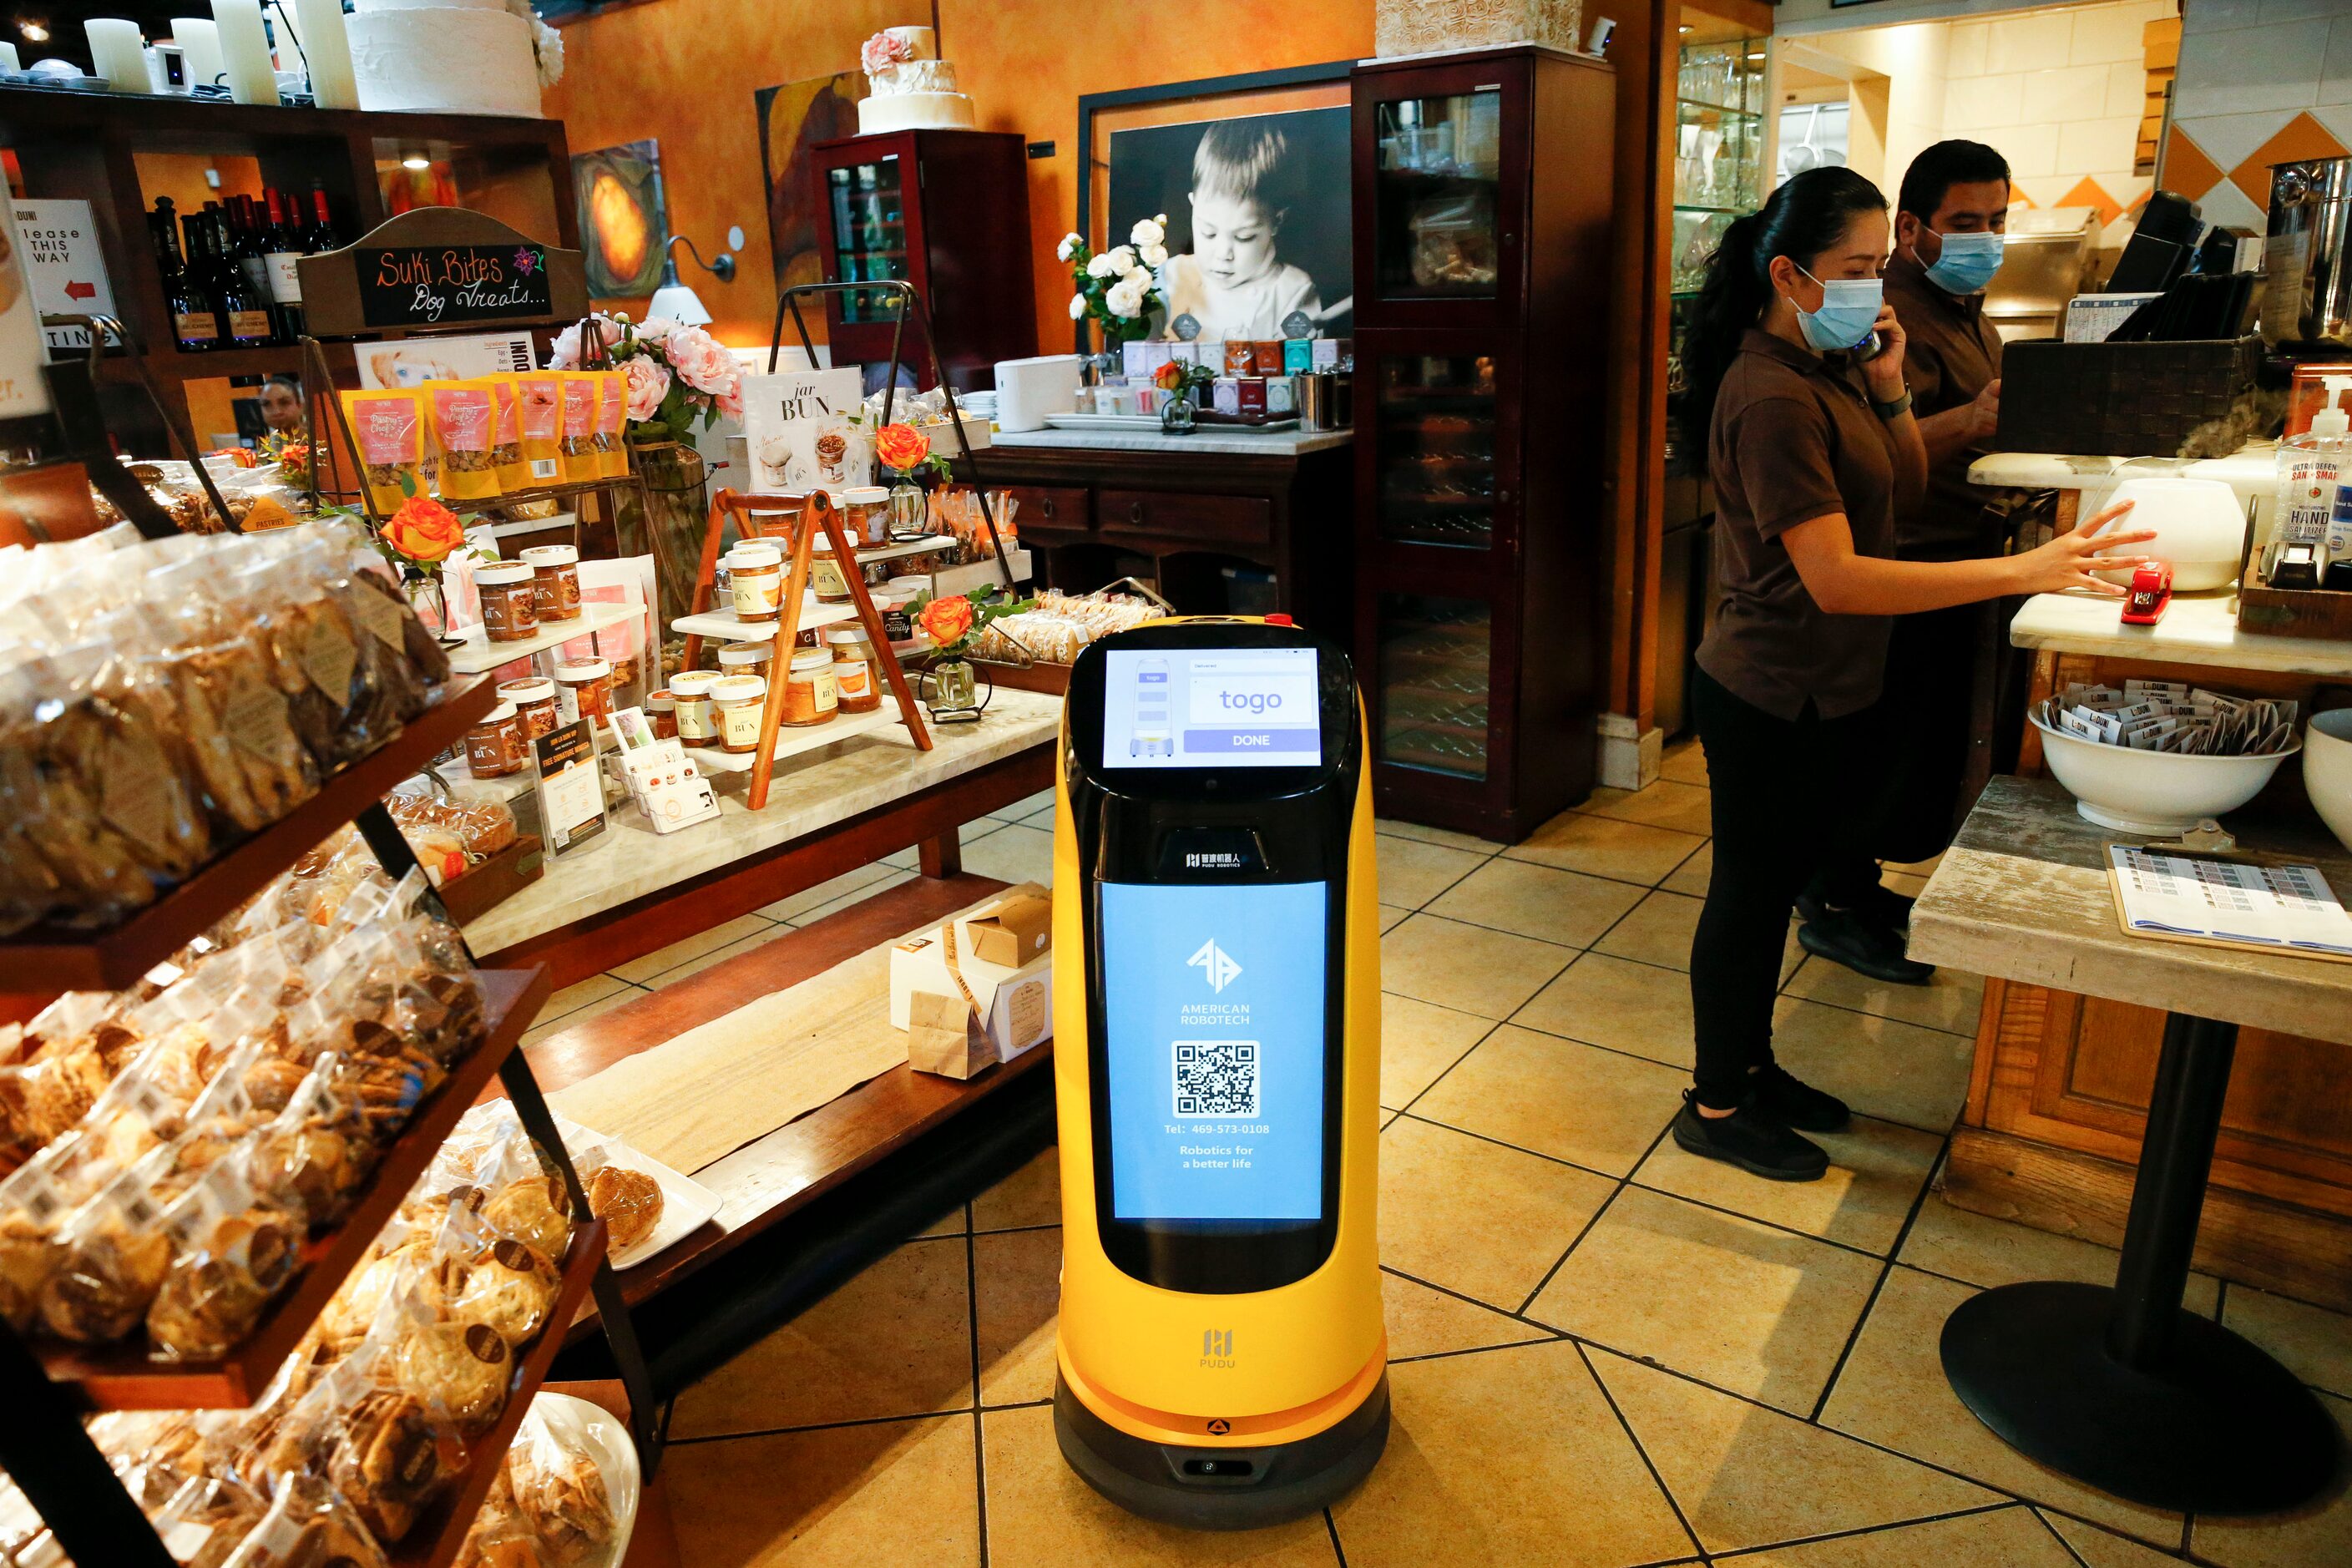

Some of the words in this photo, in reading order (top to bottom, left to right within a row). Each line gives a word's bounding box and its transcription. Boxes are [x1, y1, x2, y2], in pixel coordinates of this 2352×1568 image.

[23, 229, 79, 239] lease
[31, 240, 67, 250] THIS
[33, 253, 70, 263] WAY
[438, 248, 502, 286] Bites
[409, 283, 445, 321] Dog
[793, 382, 816, 401] jar
[780, 396, 830, 422] BUN
[424, 471, 436, 481] for
[2291, 471, 2308, 481] SAN
[2290, 510, 2329, 524] HAND
[255, 518, 285, 529] PASTRIES
[534, 591, 554, 600] BUN
[484, 609, 503, 619] BUN
[885, 623, 911, 634] Candy
[1219, 690, 1282, 714] togo
[1232, 735, 1271, 746] DONE
[474, 750, 496, 758] BUN
[543, 756, 554, 767] FREE
[1181, 1004, 1250, 1014] AMERICAN
[1181, 1015, 1250, 1025] ROBOTECH
[1191, 1124, 1270, 1134] 469-573-0108
[1180, 1145, 1232, 1155] Robotics
[1235, 1145, 1254, 1155] for
[1182, 1160, 1190, 1168] a
[1192, 1158, 1229, 1168] better
[1232, 1158, 1252, 1168] life
[1199, 1358, 1236, 1368] PUDU
